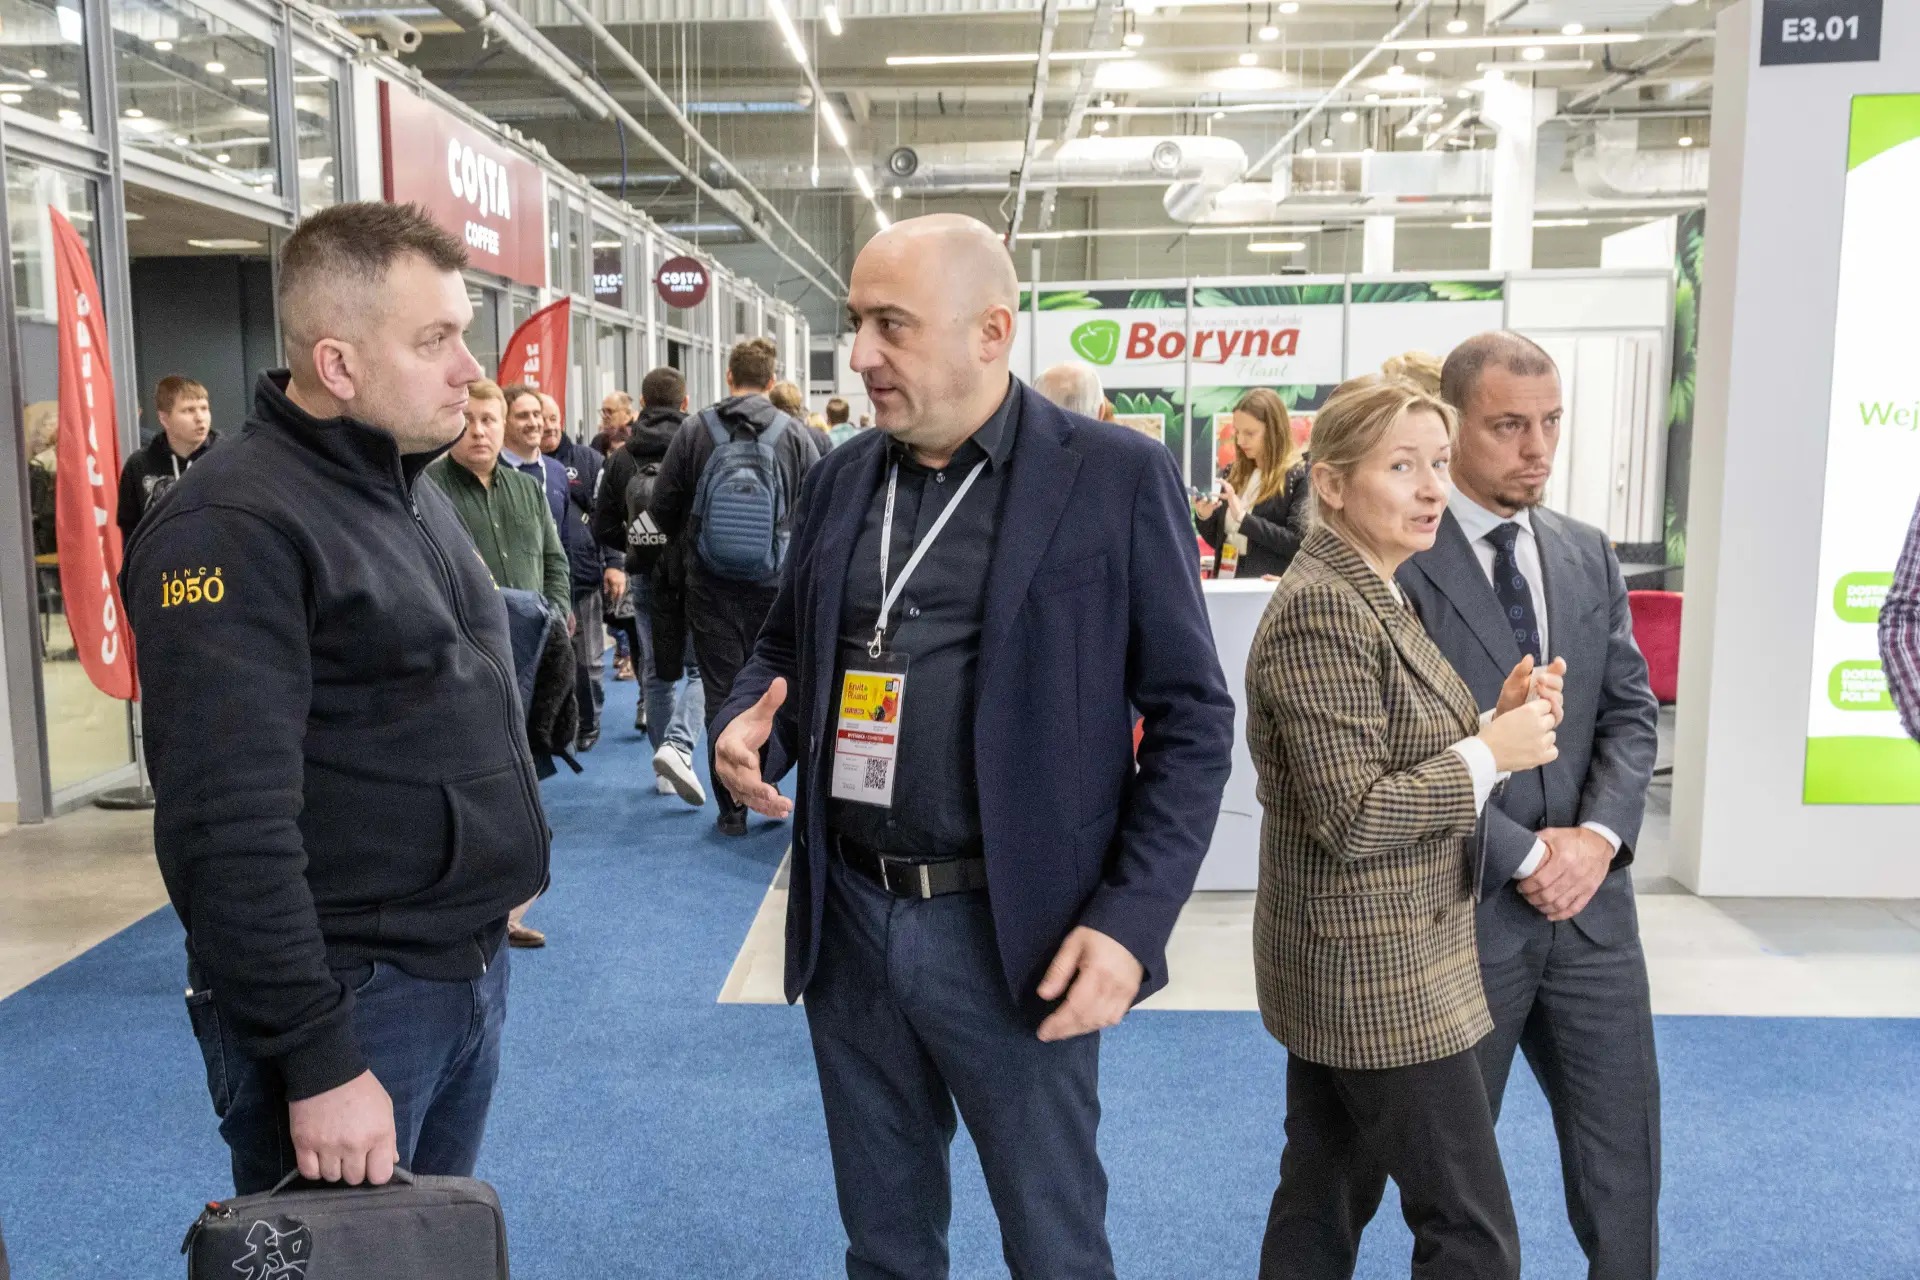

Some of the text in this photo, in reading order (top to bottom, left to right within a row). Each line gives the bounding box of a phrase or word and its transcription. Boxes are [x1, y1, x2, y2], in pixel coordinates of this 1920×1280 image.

[1781, 15, 1860, 43] E3.01
[447, 136, 511, 220] COSTA
[465, 220, 500, 256] COFFEE
[660, 271, 704, 286] COSTA
[1125, 320, 1301, 365] Boryna
[627, 533, 668, 545] adidas
[161, 566, 222, 581] SINCE
[161, 576, 225, 608] 1950
